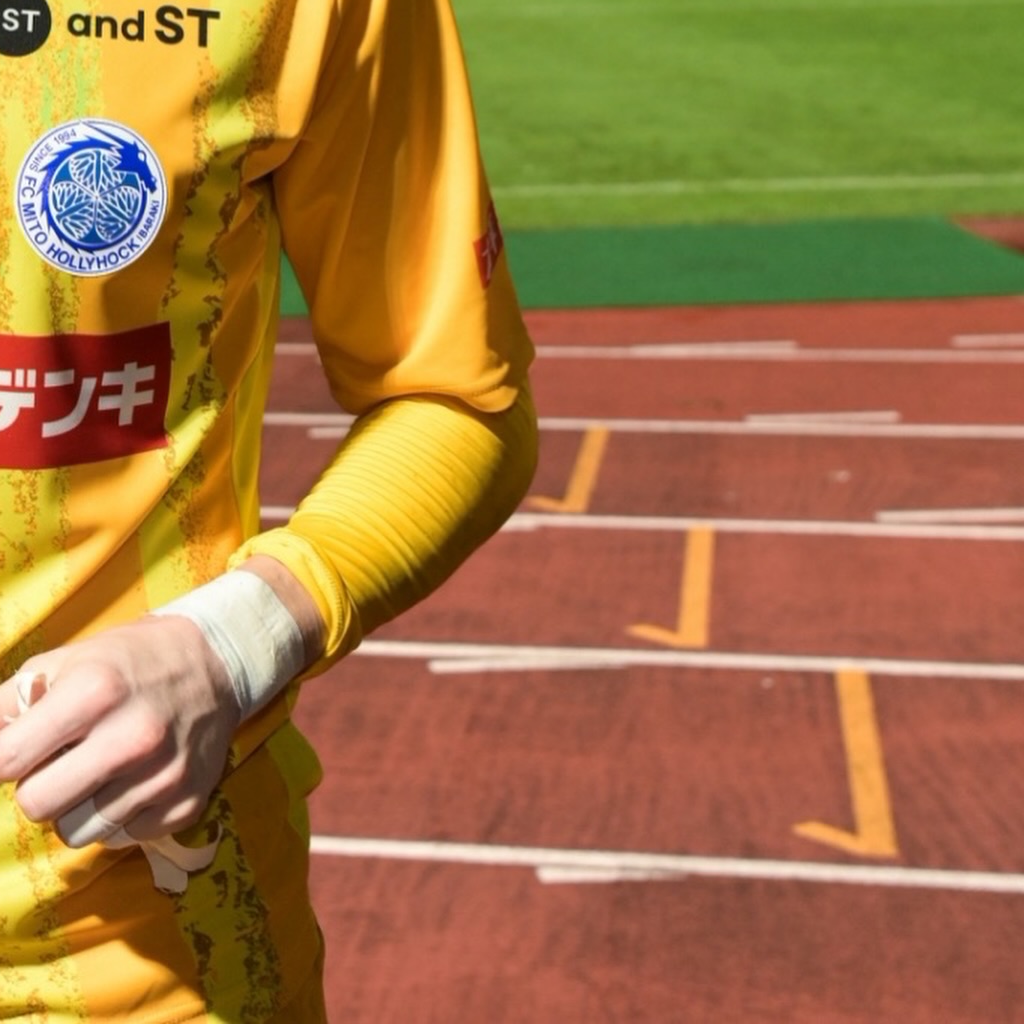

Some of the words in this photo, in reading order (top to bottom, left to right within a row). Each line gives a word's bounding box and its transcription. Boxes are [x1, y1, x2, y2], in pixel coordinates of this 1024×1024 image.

[2, 8, 41, 32] ST
[67, 8, 145, 41] and
[153, 5, 221, 48] ST
[29, 143, 53, 172] SINCE
[54, 129, 77, 145] 1994
[21, 176, 37, 199] FC
[21, 201, 48, 245] MITO
[47, 238, 140, 270] HOLLYHOCK
